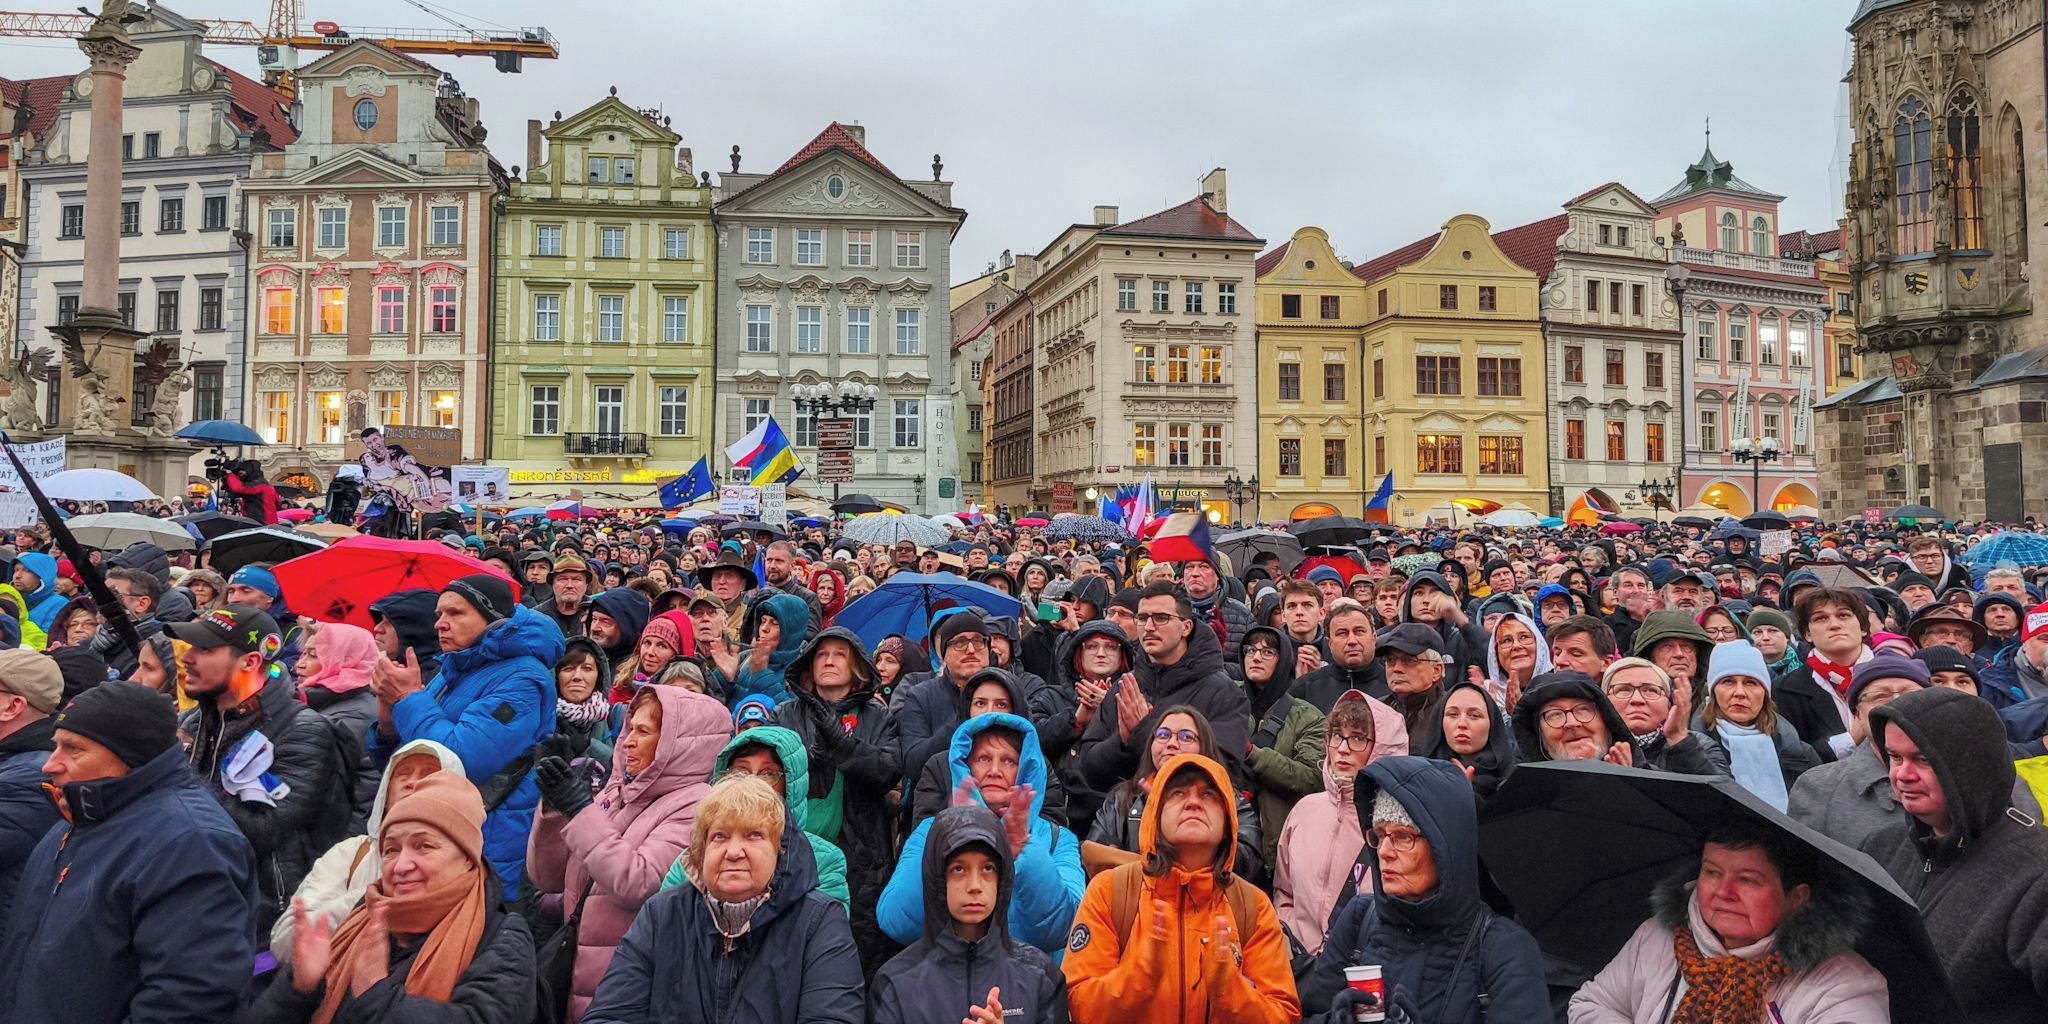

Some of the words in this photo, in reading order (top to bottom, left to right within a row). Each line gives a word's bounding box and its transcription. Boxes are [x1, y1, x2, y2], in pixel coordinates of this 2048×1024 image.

[322, 37, 353, 45] LIEBH
[935, 408, 944, 468] HOTEL
[1160, 489, 1209, 497] TABUCKS
